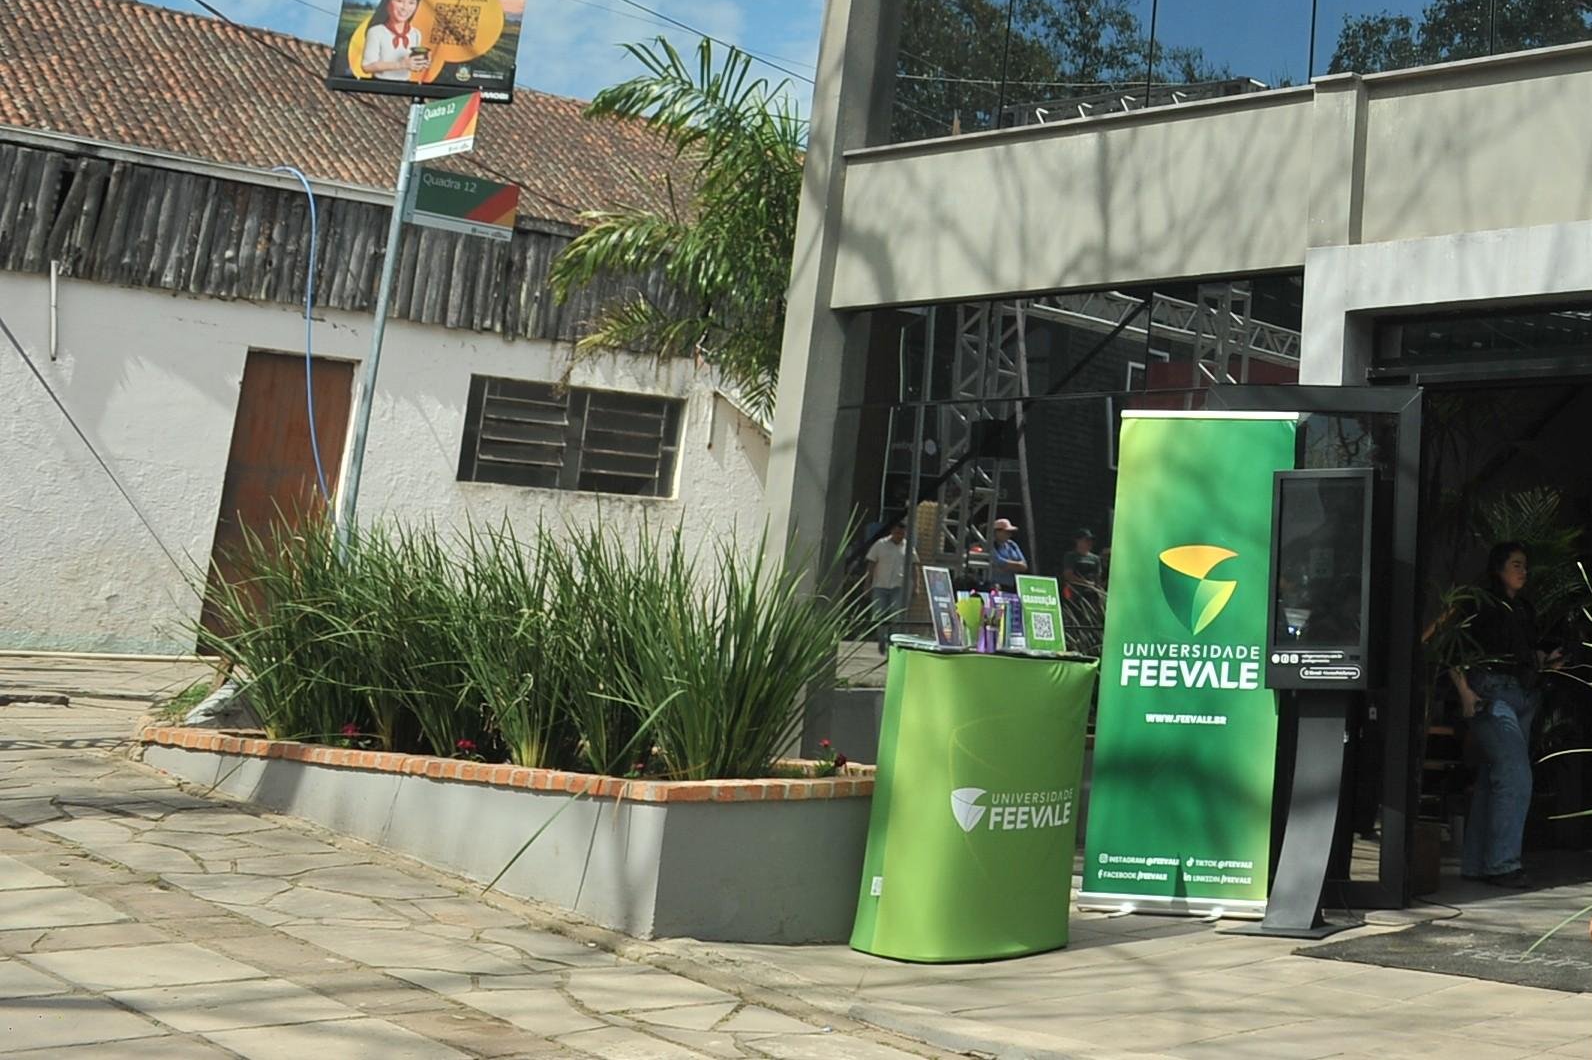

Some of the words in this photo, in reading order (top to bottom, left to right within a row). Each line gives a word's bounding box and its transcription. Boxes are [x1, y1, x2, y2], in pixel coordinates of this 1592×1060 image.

[424, 107, 447, 121] Quadra
[447, 102, 456, 114] 12
[423, 172, 461, 189] Quadra
[464, 182, 477, 194] 12
[1123, 642, 1260, 660] UNIVERSIDADE
[1120, 658, 1259, 690] FEEVALE
[991, 788, 1074, 805] UNIVERSIDADE
[988, 802, 1072, 831] FEEVALE
